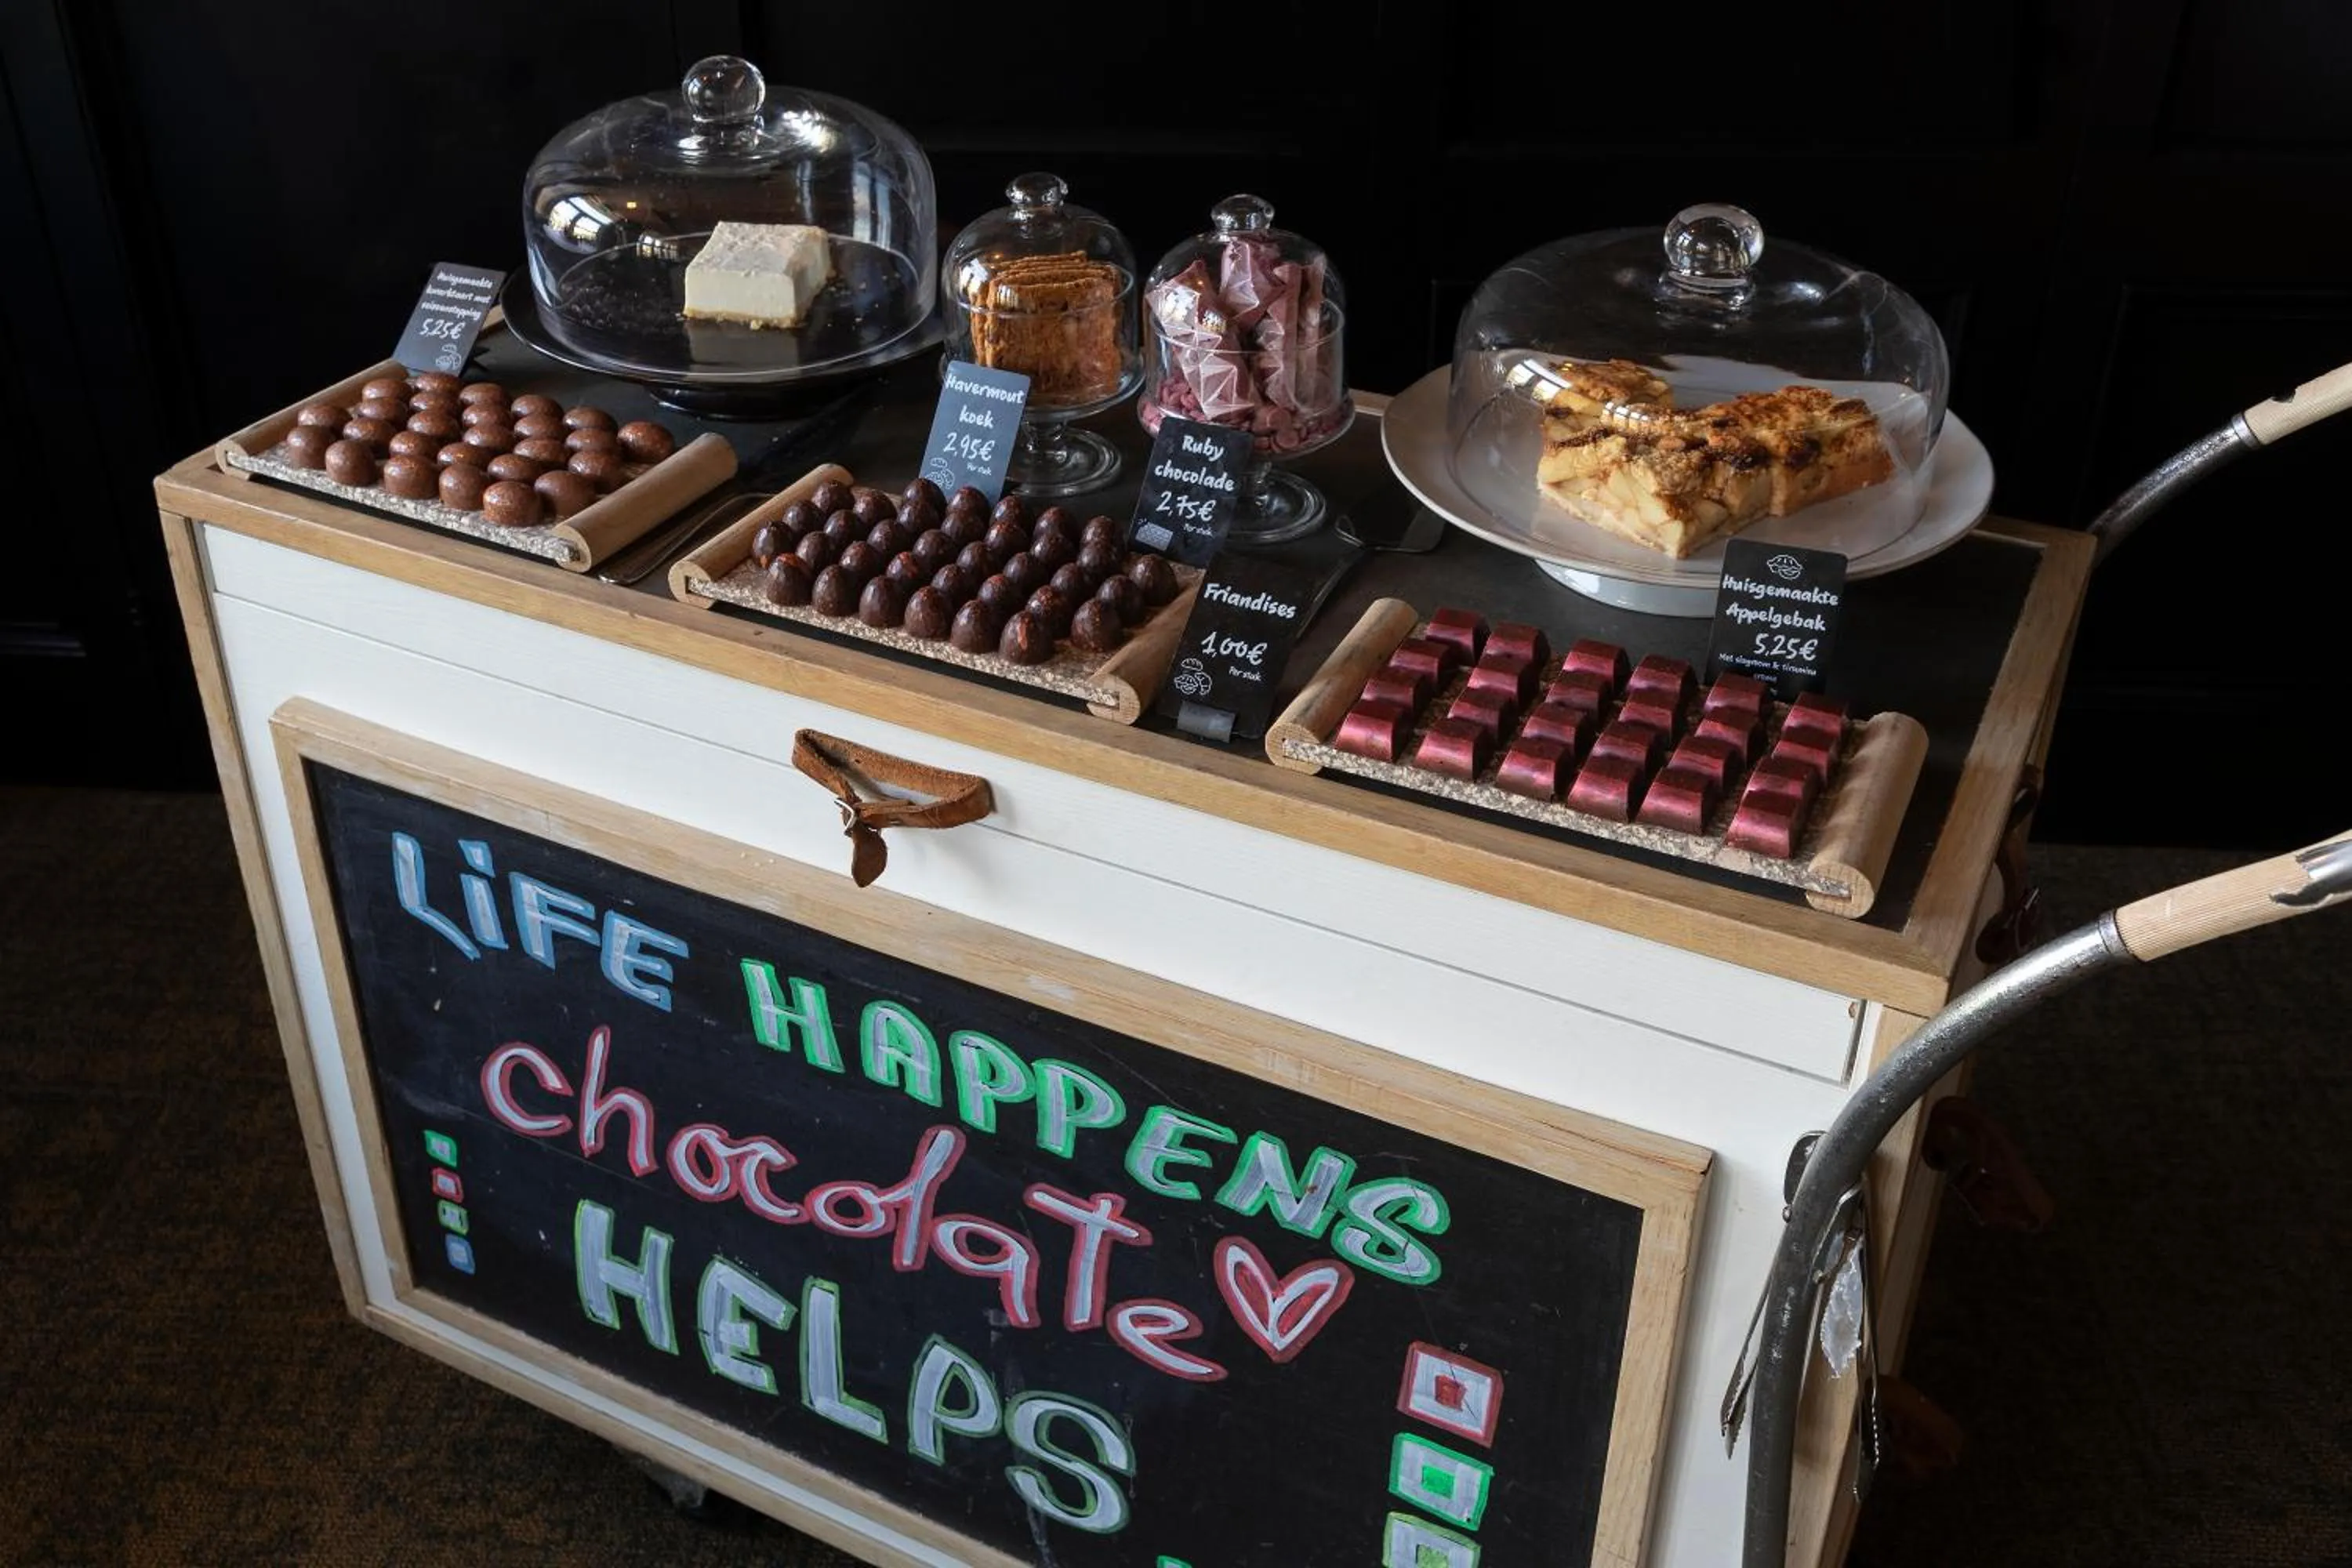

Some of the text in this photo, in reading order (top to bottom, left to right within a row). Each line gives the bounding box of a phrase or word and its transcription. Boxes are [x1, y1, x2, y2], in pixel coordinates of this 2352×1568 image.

[944, 373, 1025, 404] Havermout
[959, 405, 994, 429] koek
[943, 432, 996, 462] 2,95€
[1181, 434, 1224, 462] Ruby
[1154, 459, 1235, 492] chocolade
[1156, 491, 1217, 521] 2,75€
[1203, 583, 1297, 619] Friandises
[1722, 574, 1838, 606] Huisgemaakte
[1726, 601, 1826, 631] Appelgebak
[1201, 631, 1268, 666] 1,00€
[1753, 633, 1818, 661] 5,25€
[740, 957, 1451, 1286] HAPPENS
[574, 1199, 1136, 1534] HELPS
